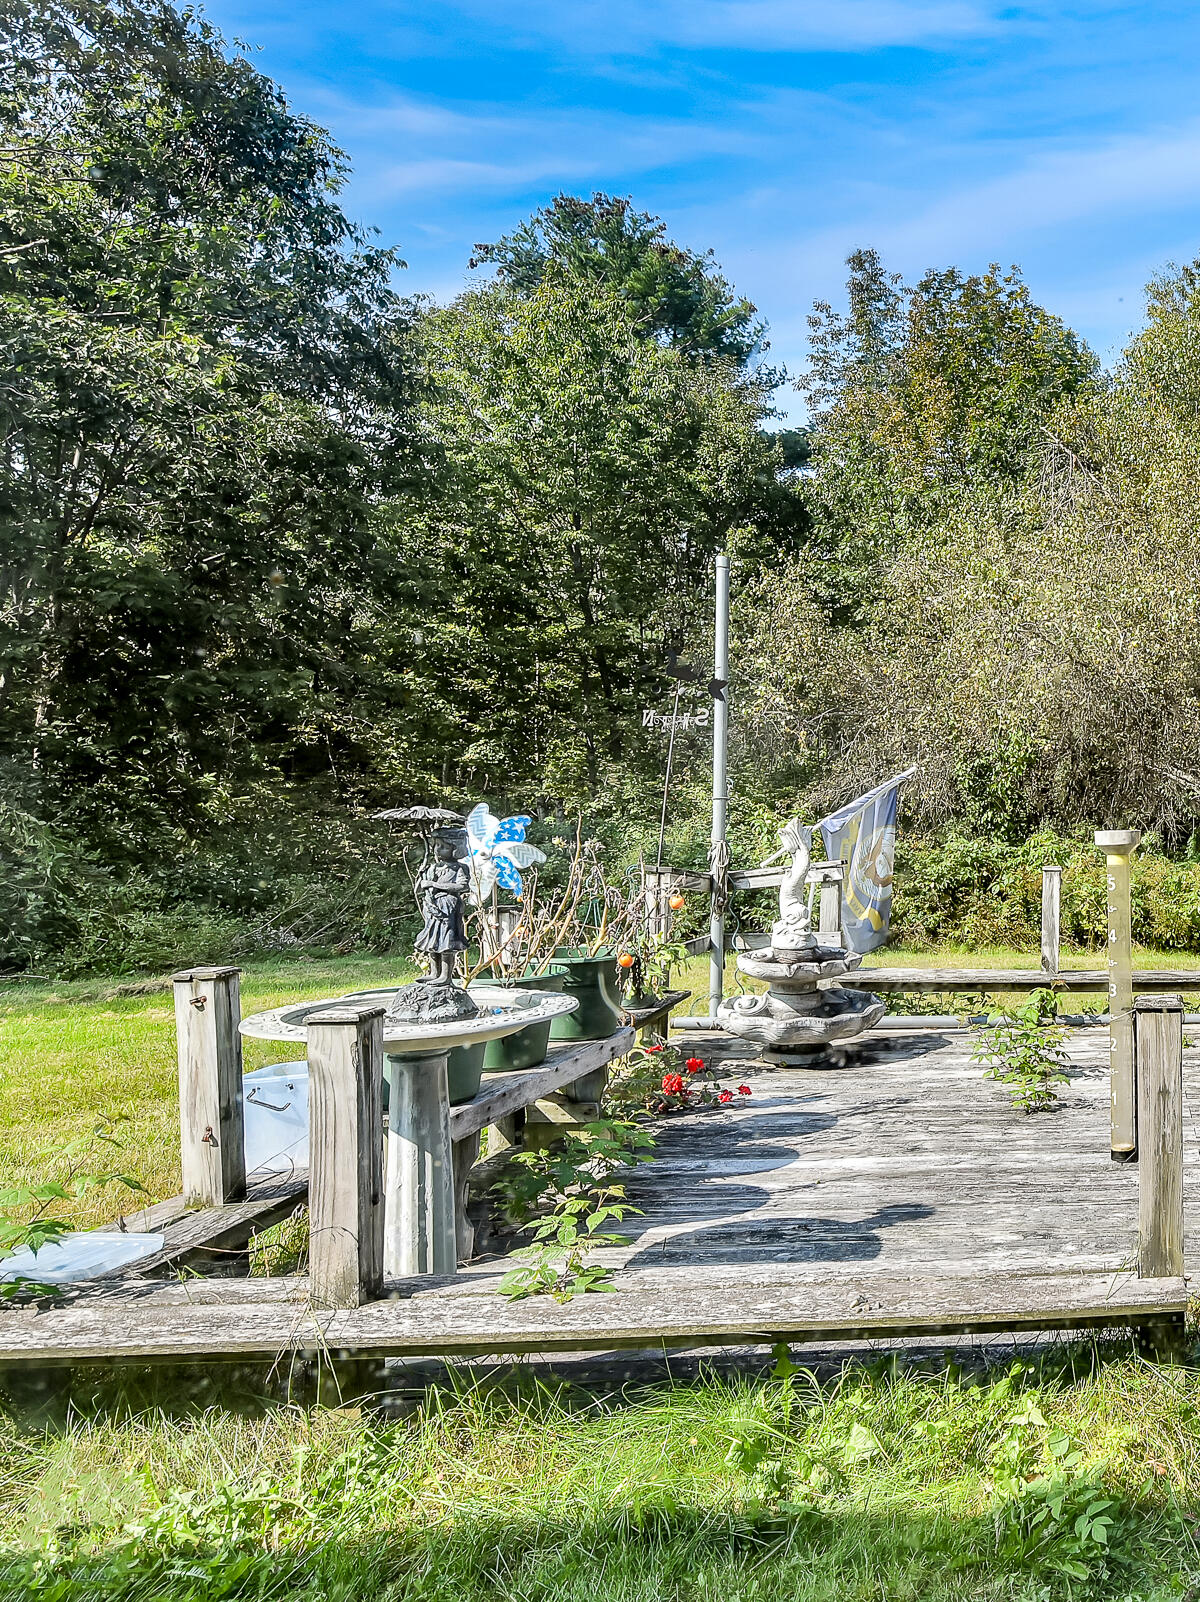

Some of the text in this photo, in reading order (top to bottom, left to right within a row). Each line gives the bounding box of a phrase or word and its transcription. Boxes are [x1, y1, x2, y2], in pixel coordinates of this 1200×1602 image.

[1108, 877, 1116, 891] 5
[1109, 929, 1117, 943] 4
[1109, 983, 1117, 998] 3
[1110, 1037, 1118, 1052] 2
[1111, 1090, 1117, 1106] 1
